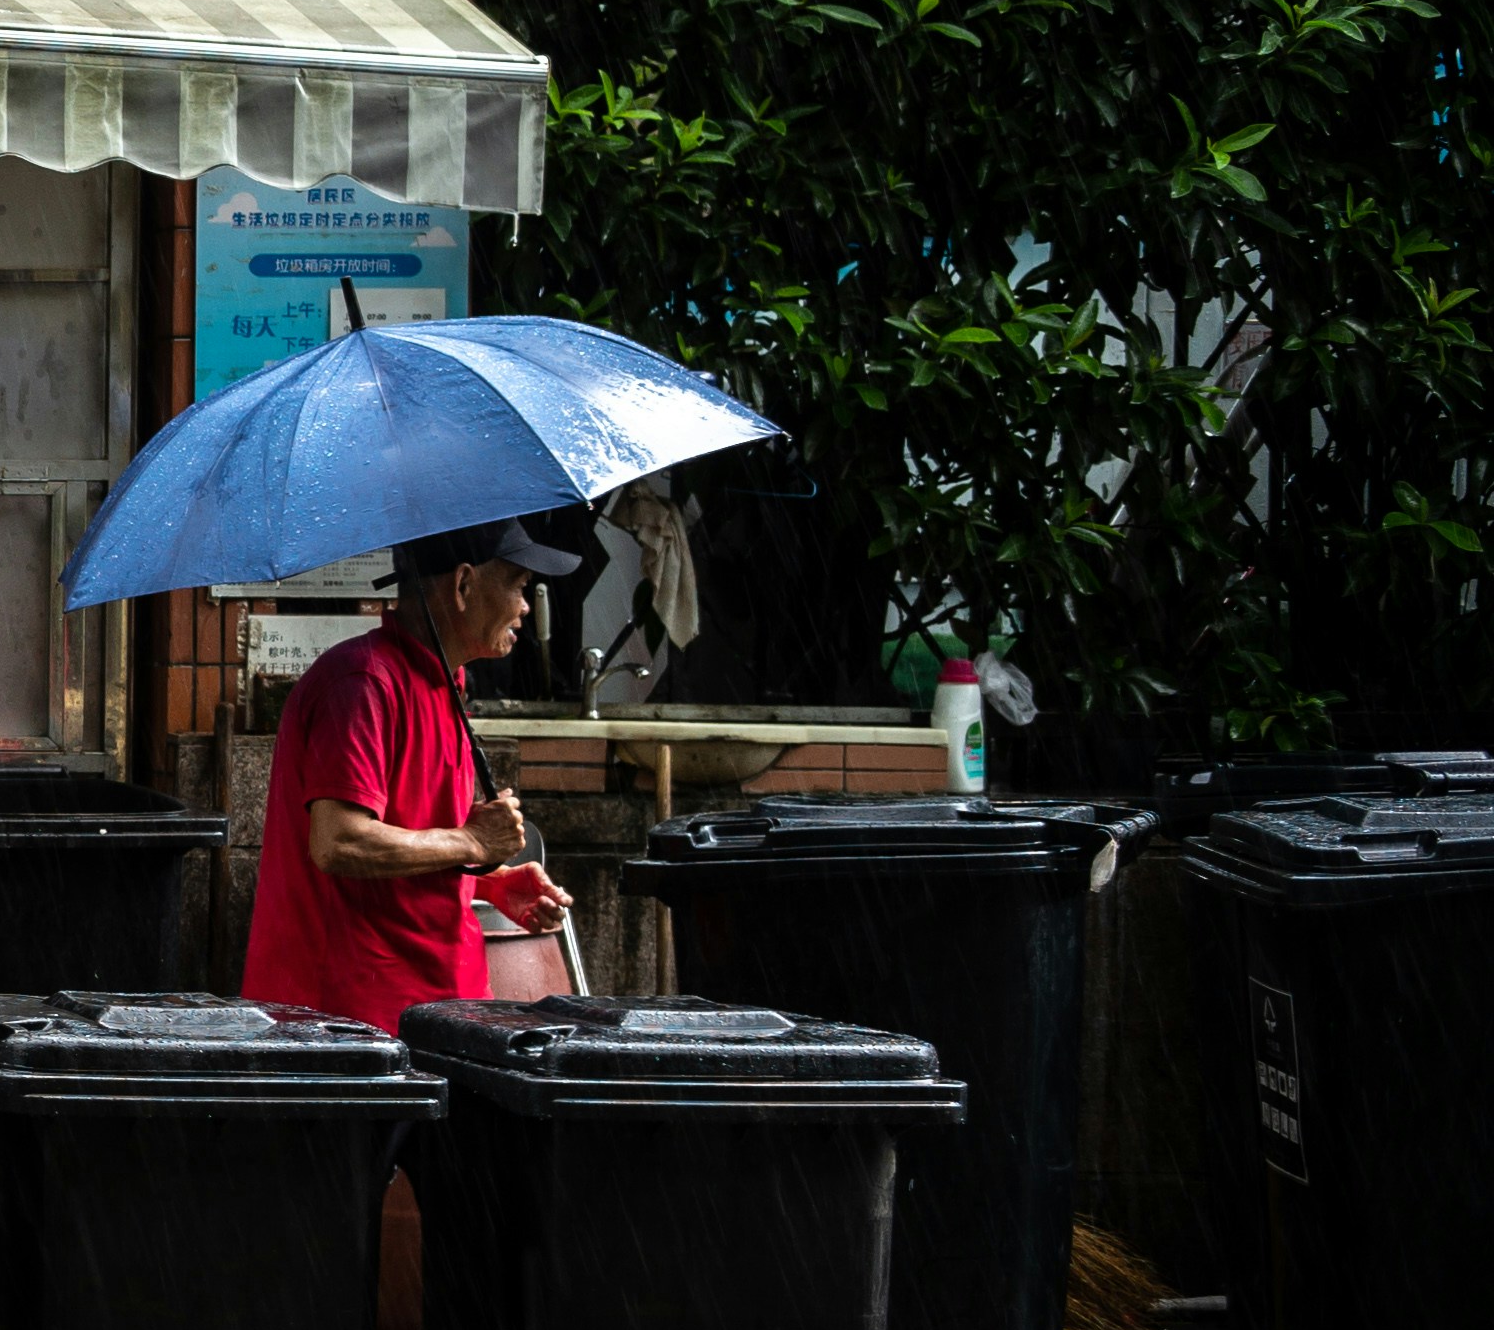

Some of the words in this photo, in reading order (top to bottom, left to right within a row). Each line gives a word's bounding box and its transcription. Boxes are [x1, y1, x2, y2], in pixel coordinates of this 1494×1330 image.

[307, 188, 357, 206] 居民区
[231, 211, 431, 230] 生活垃圾定时定点分类投放
[231, 314, 278, 338] 每天
[366, 313, 387, 321] 07:00
